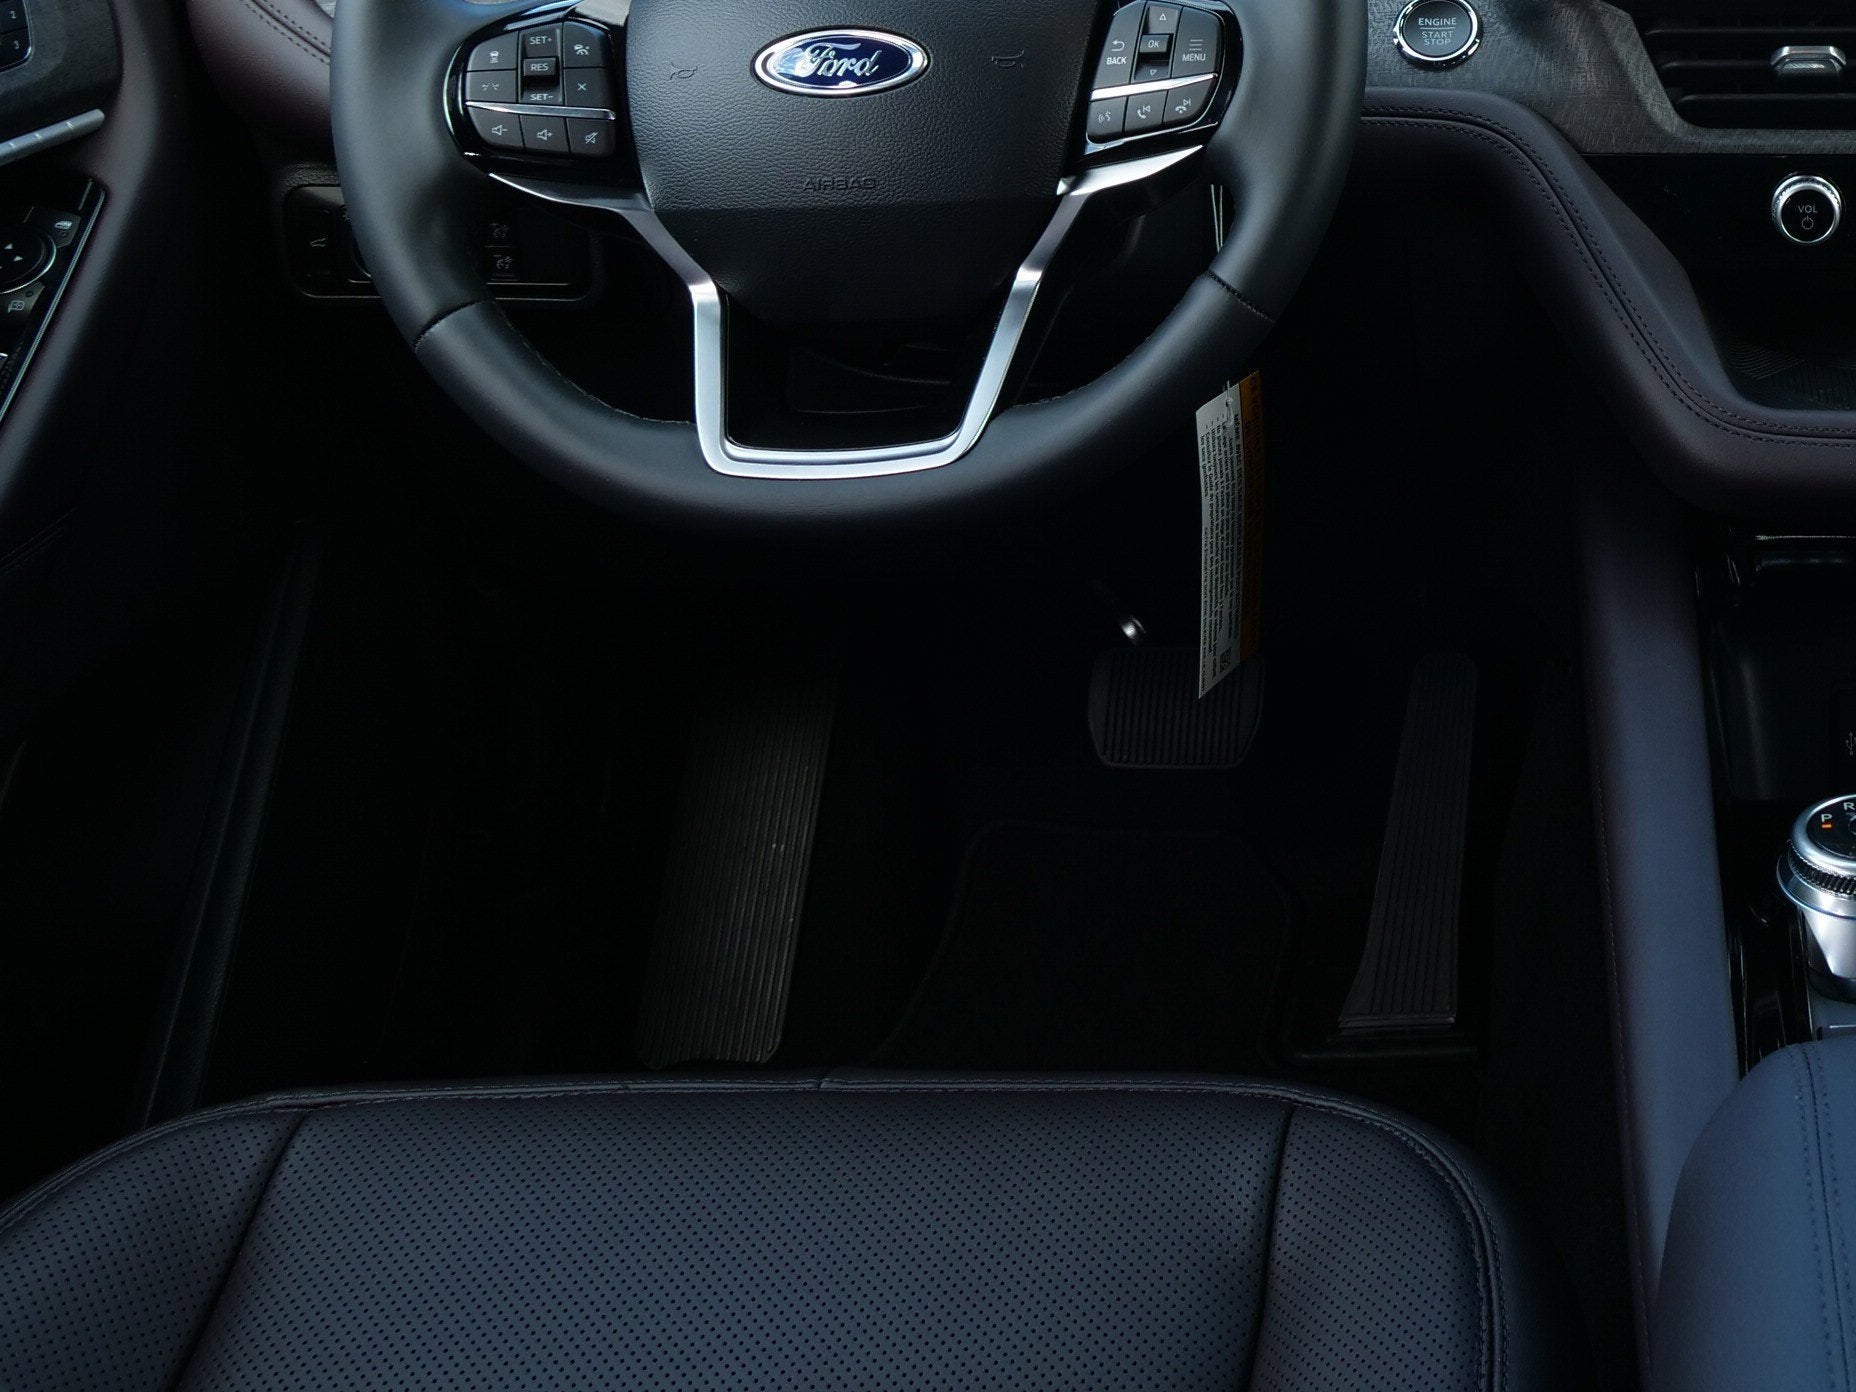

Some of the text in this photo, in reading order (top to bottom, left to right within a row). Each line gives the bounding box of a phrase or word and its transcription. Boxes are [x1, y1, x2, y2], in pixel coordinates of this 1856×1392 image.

[10, 10, 17, 19] 2
[1417, 17, 1457, 26] ENGINE
[1421, 30, 1453, 39] START
[530, 35, 553, 45] SET+
[1147, 40, 1160, 48] OK
[1423, 38, 1452, 46] STOP
[793, 41, 883, 78] Ford
[1106, 56, 1127, 65] BACK
[1181, 53, 1207, 62] MENU
[530, 62, 549, 72] RES
[803, 179, 878, 192] AIRBAG
[1797, 204, 1818, 214] VOL
[1843, 801, 1856, 811] R
[1821, 813, 1832, 822] P
